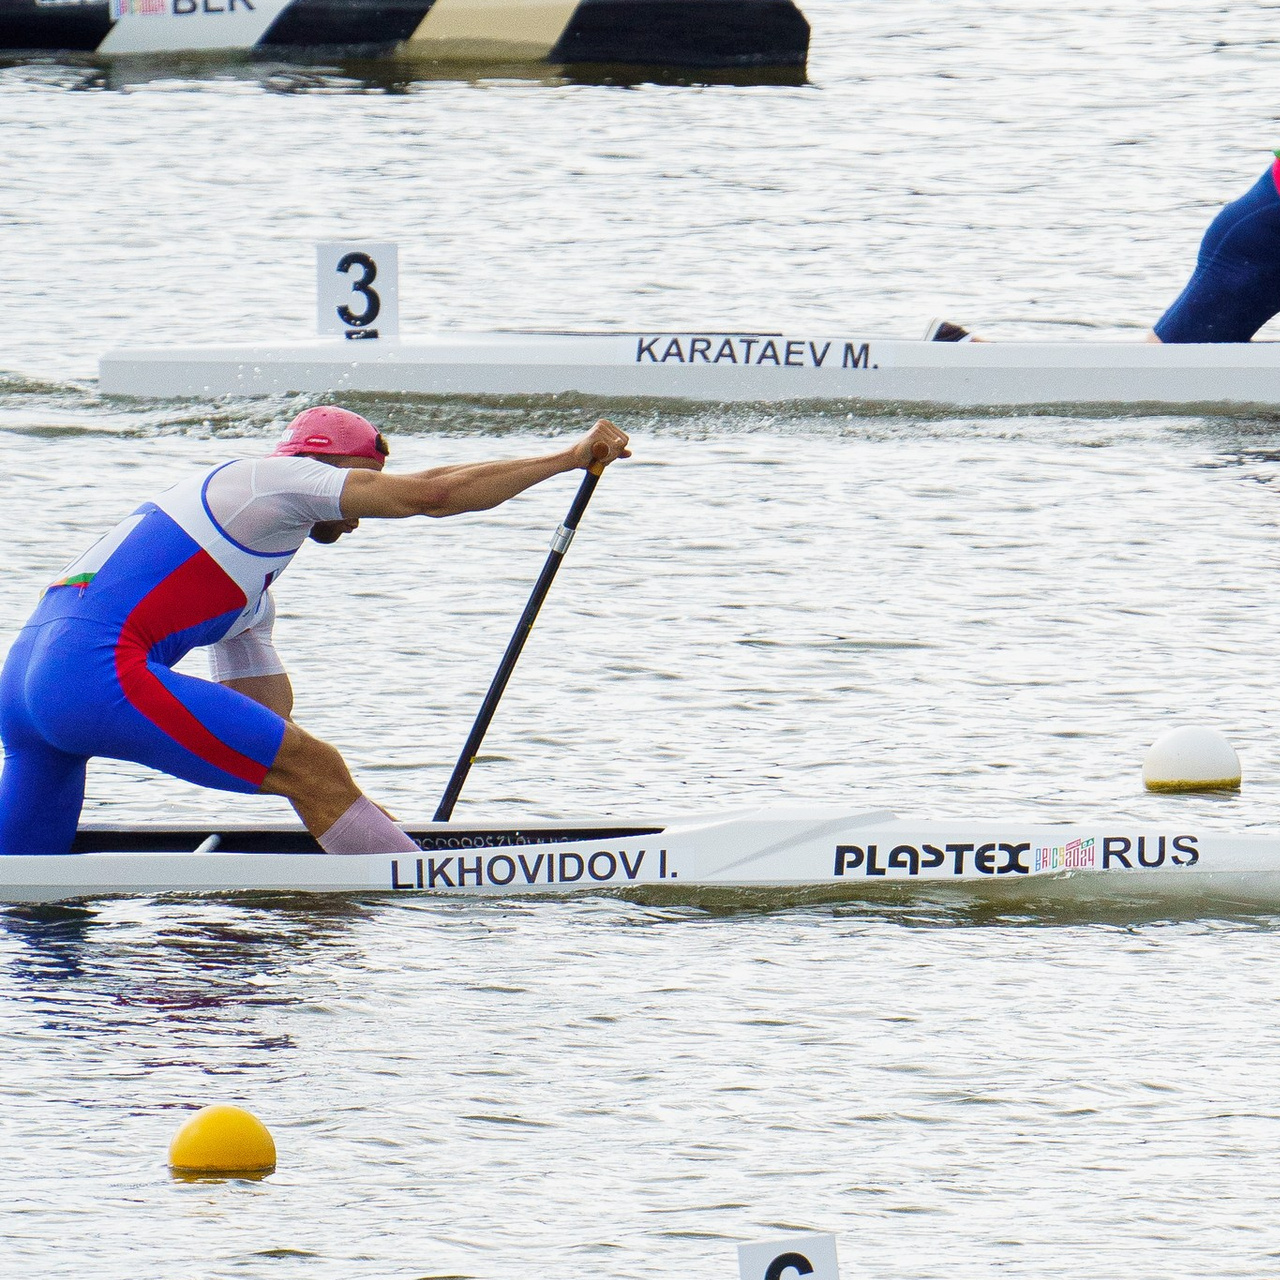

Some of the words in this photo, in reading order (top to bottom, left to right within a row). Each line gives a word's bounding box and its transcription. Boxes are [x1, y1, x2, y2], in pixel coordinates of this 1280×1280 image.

[336, 251, 381, 327] 3
[636, 337, 831, 367] KARATAEV
[841, 342, 879, 370] M.
[390, 849, 646, 889] LIKHOVIDOV
[659, 849, 678, 878] I.
[833, 842, 1031, 876] PLASTEX
[1065, 845, 1095, 867] 2024
[1102, 835, 1200, 869] RUS
